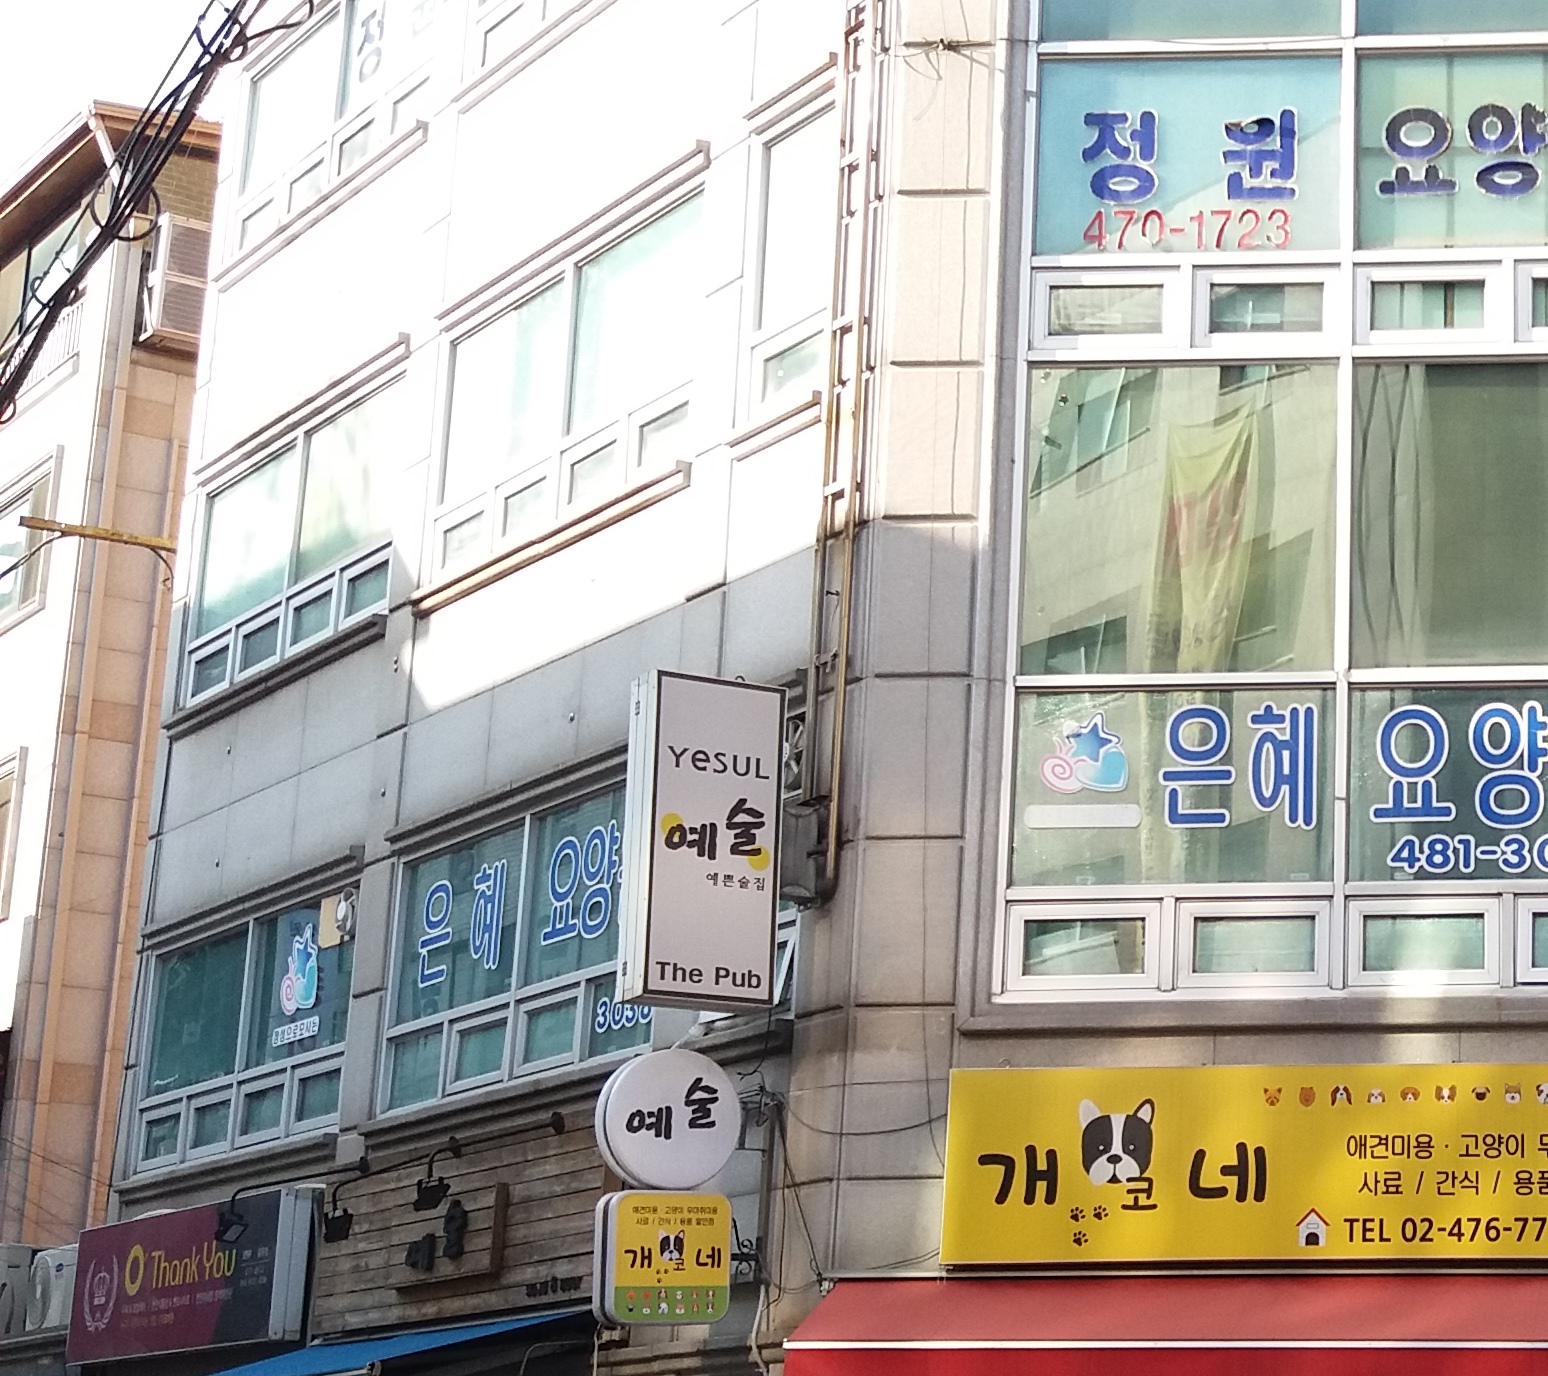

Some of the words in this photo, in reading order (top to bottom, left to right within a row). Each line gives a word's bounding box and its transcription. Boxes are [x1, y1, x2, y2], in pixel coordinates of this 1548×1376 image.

[1082, 208, 1292, 251] 470-1723
[1159, 701, 1318, 830] 은혜
[664, 797, 767, 861] 예술
[418, 856, 508, 989] 은혜
[541, 818, 623, 946] 요양
[705, 872, 766, 892] 예쁜술집
[655, 961, 703, 985] The
[714, 965, 762, 990] Pub
[626, 1076, 719, 1141] 예술
[1346, 1132, 1435, 1161] 애견미용
[1458, 1132, 1525, 1161] 고양이
[978, 1141, 1267, 1212] 개코네
[1358, 1170, 1403, 1197] 사료
[1435, 1170, 1480, 1197] 간식
[1343, 1218, 1391, 1243] TEL
[150, 1246, 200, 1289] Thank
[201, 1240, 238, 1280] You
